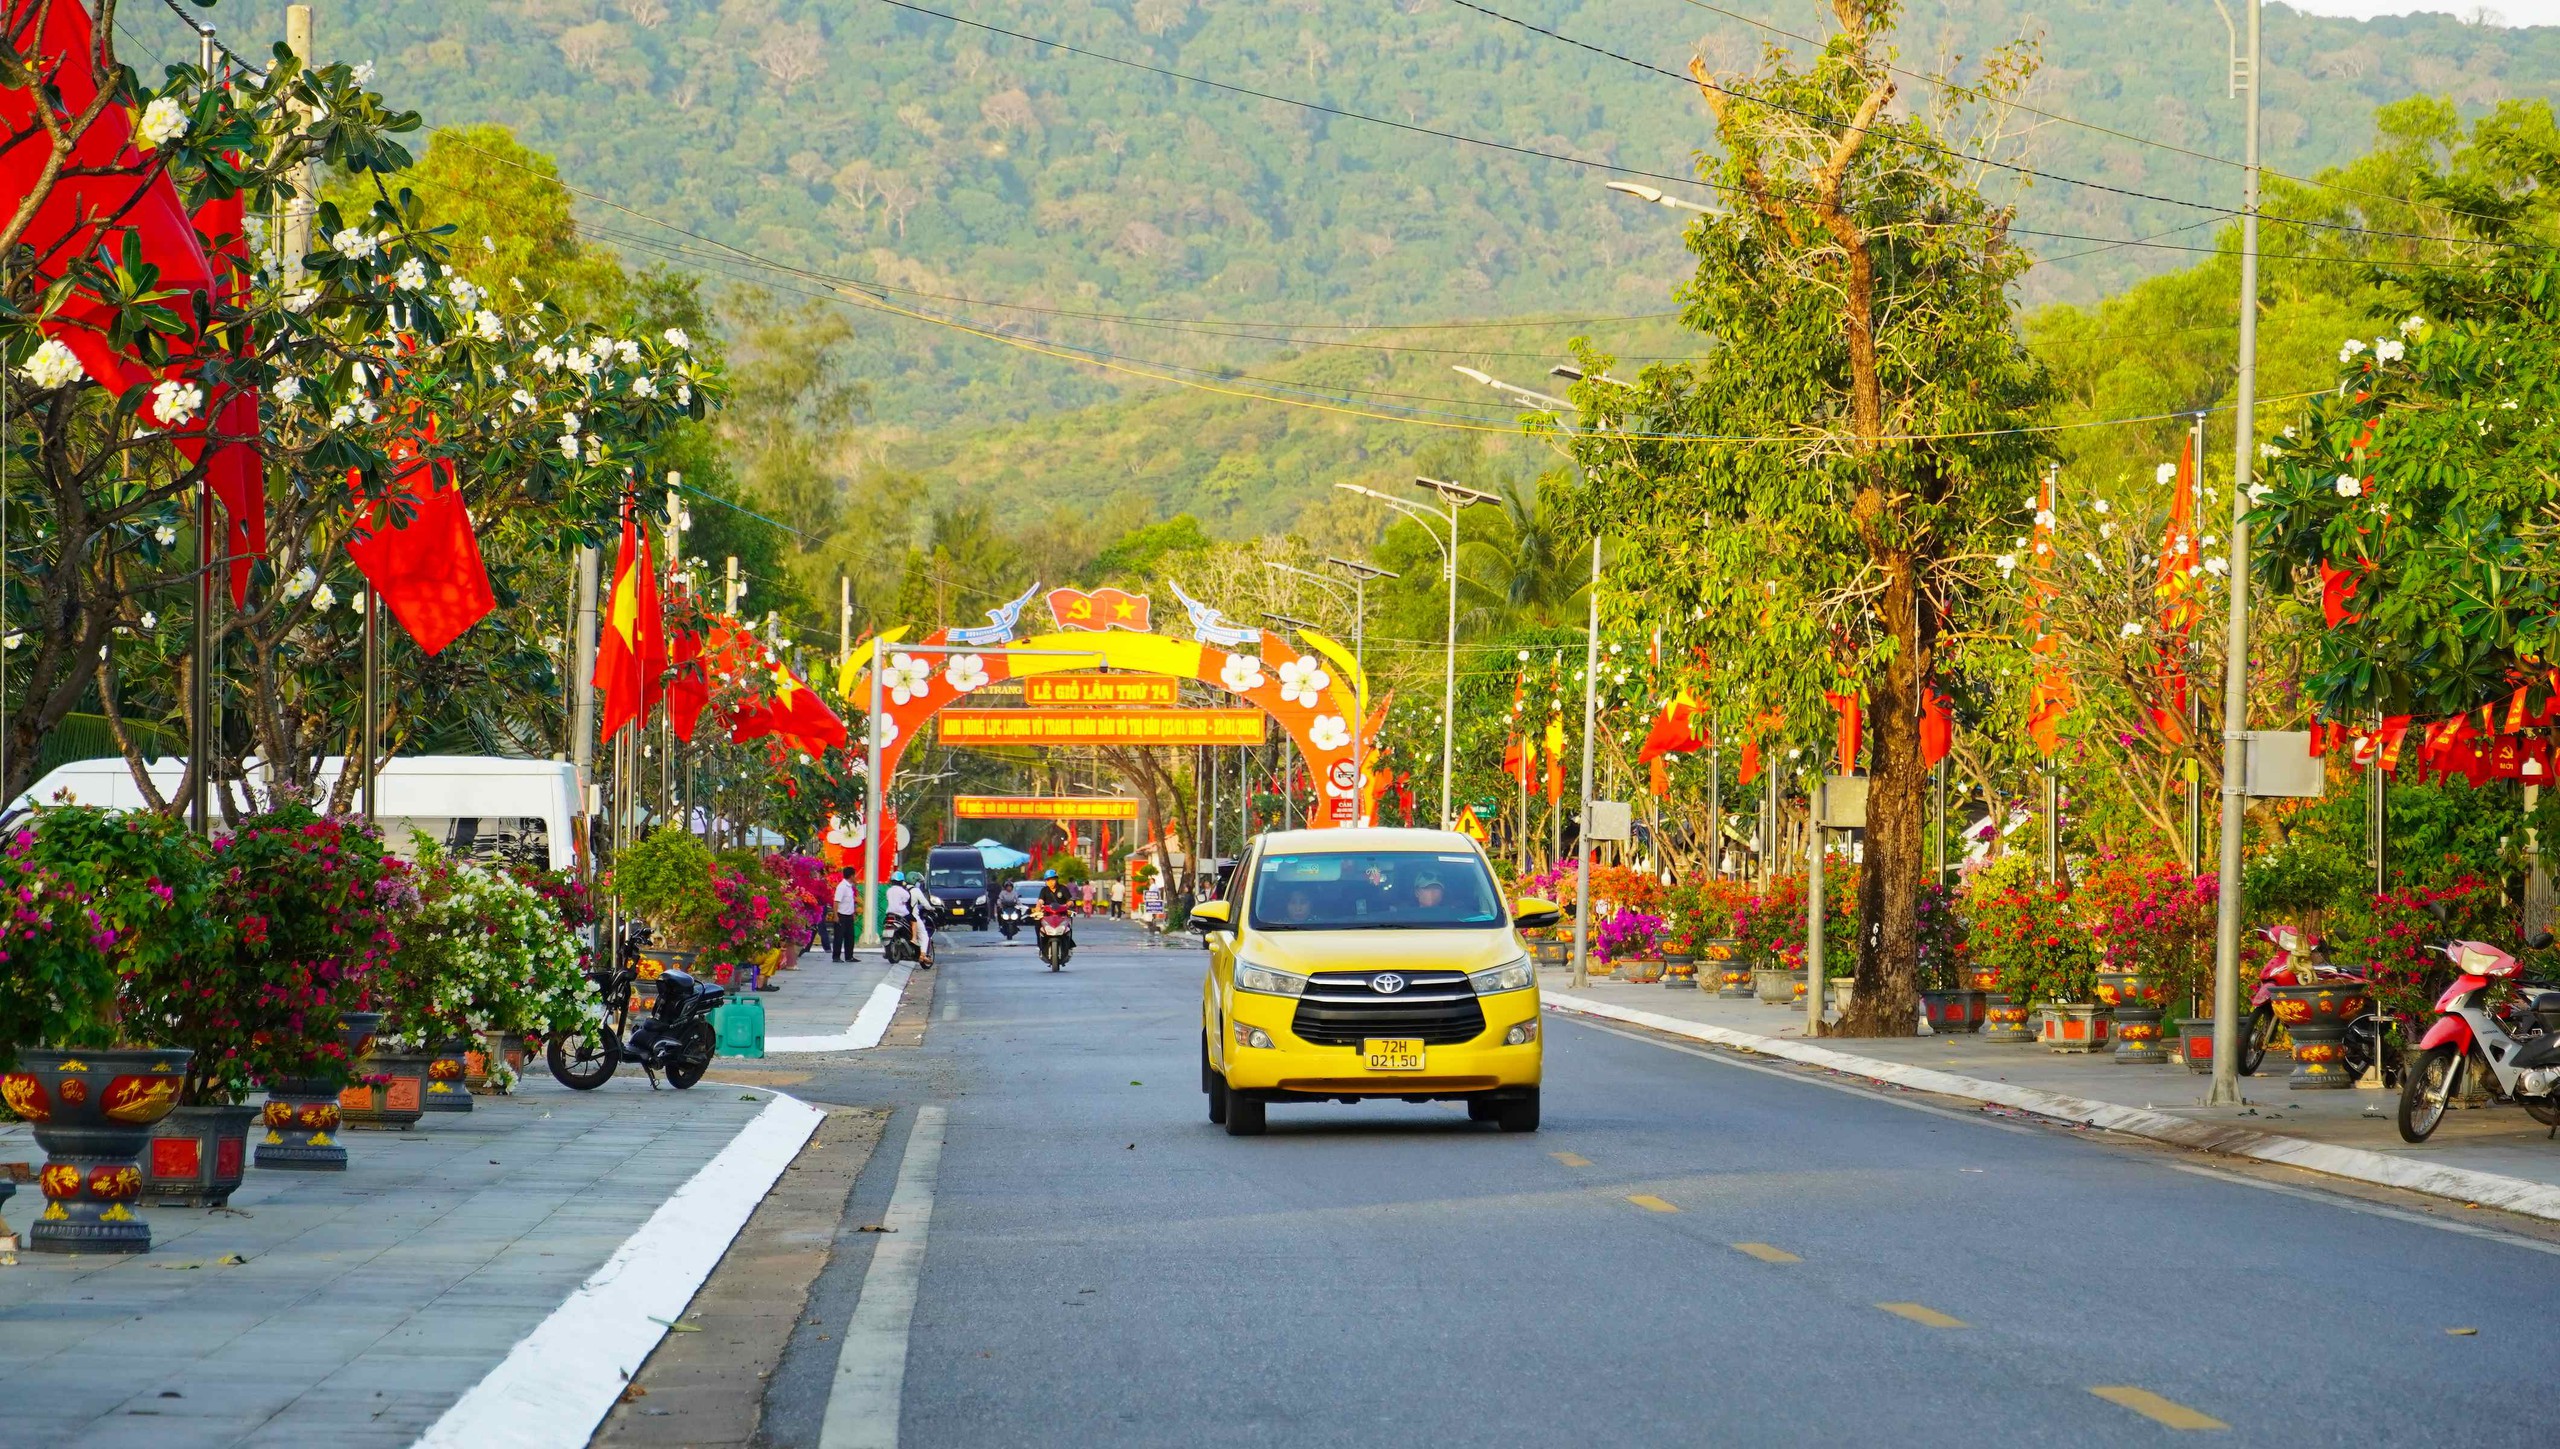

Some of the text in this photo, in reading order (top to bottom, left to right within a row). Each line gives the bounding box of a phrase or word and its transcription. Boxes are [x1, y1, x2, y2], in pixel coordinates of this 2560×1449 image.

[987, 685, 1022, 695] TRANG
[1117, 682, 1148, 700] THỨ
[1152, 684, 1169, 700] 74
[1382, 1040, 1407, 1053] 72H
[1371, 1054, 1417, 1067] 021.50
